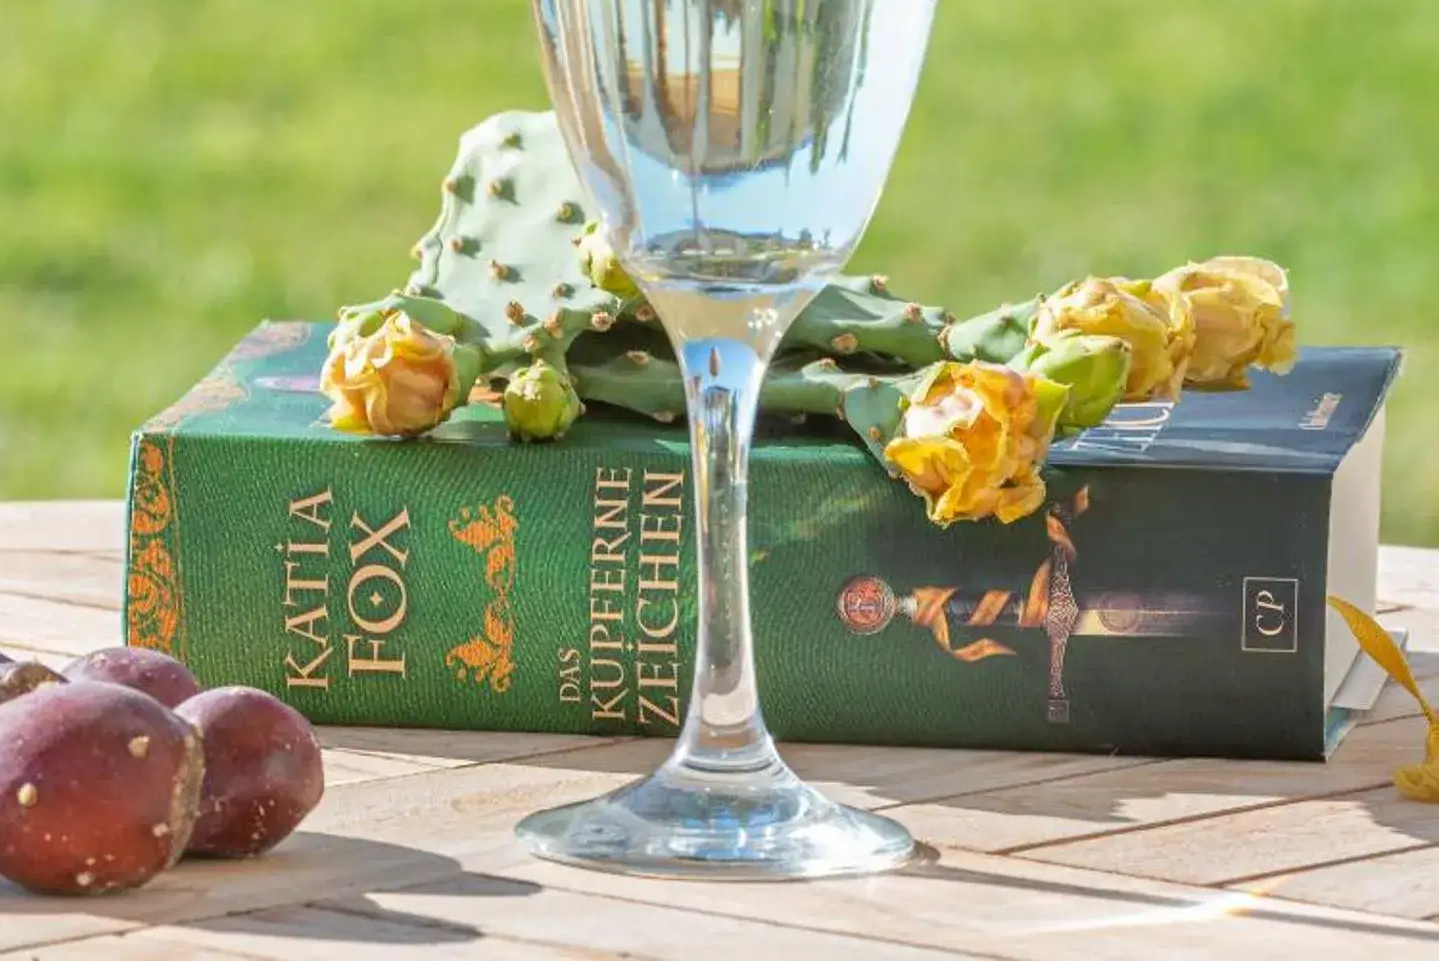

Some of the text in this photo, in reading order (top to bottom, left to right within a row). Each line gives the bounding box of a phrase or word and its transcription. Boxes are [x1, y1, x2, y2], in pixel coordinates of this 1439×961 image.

[345, 506, 412, 678] FOX
[590, 465, 633, 722] KUPFERNE
[1254, 589, 1286, 637] CP
[559, 647, 583, 705] DAS
